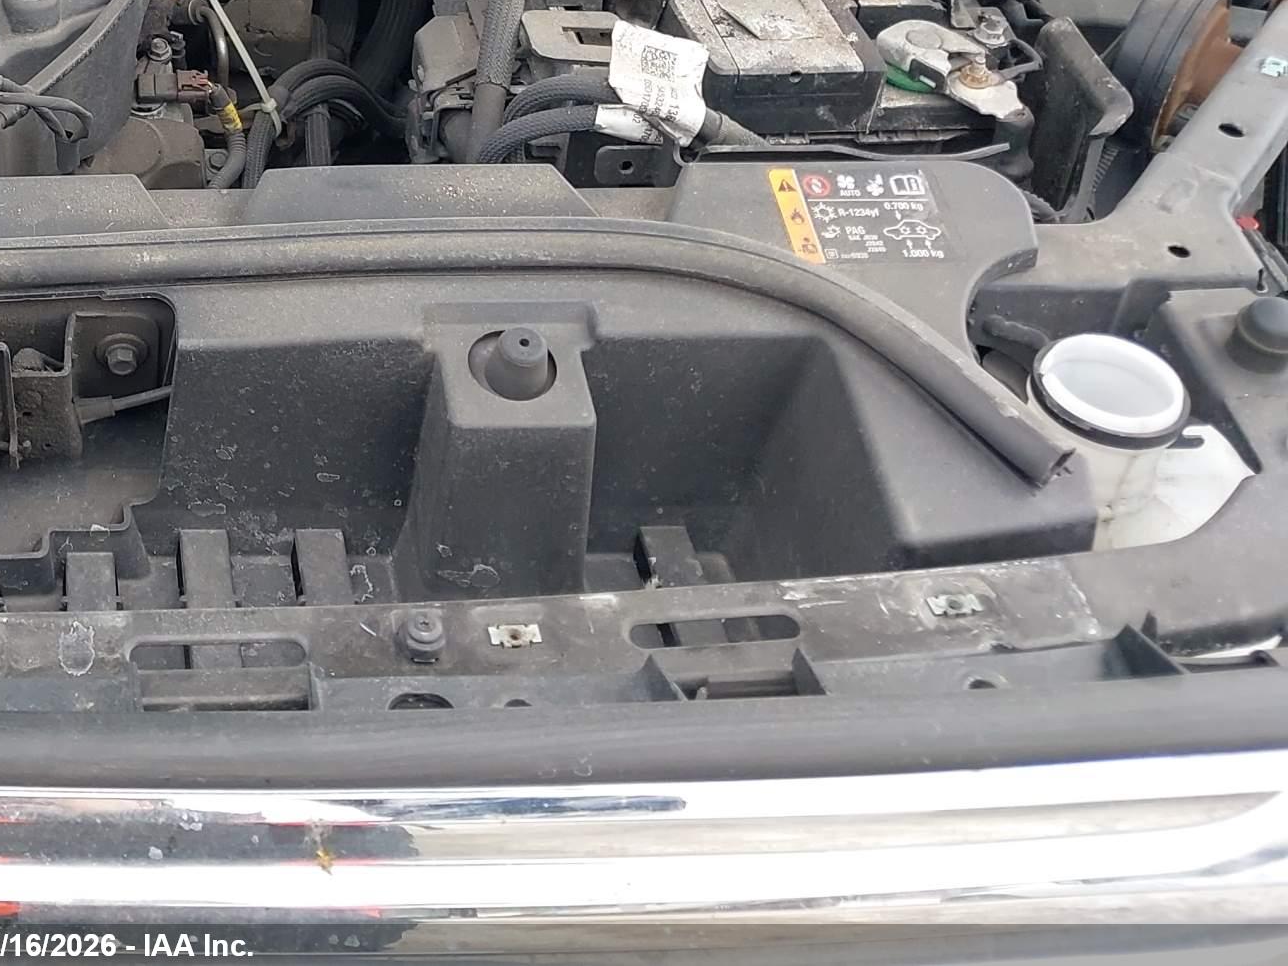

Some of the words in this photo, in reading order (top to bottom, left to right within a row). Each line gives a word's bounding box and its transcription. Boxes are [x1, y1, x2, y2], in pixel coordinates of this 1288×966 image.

[911, 202, 923, 212] kg
[845, 226, 866, 235] PAG
[903, 249, 929, 258] 1.000
[930, 250, 944, 259] kg
